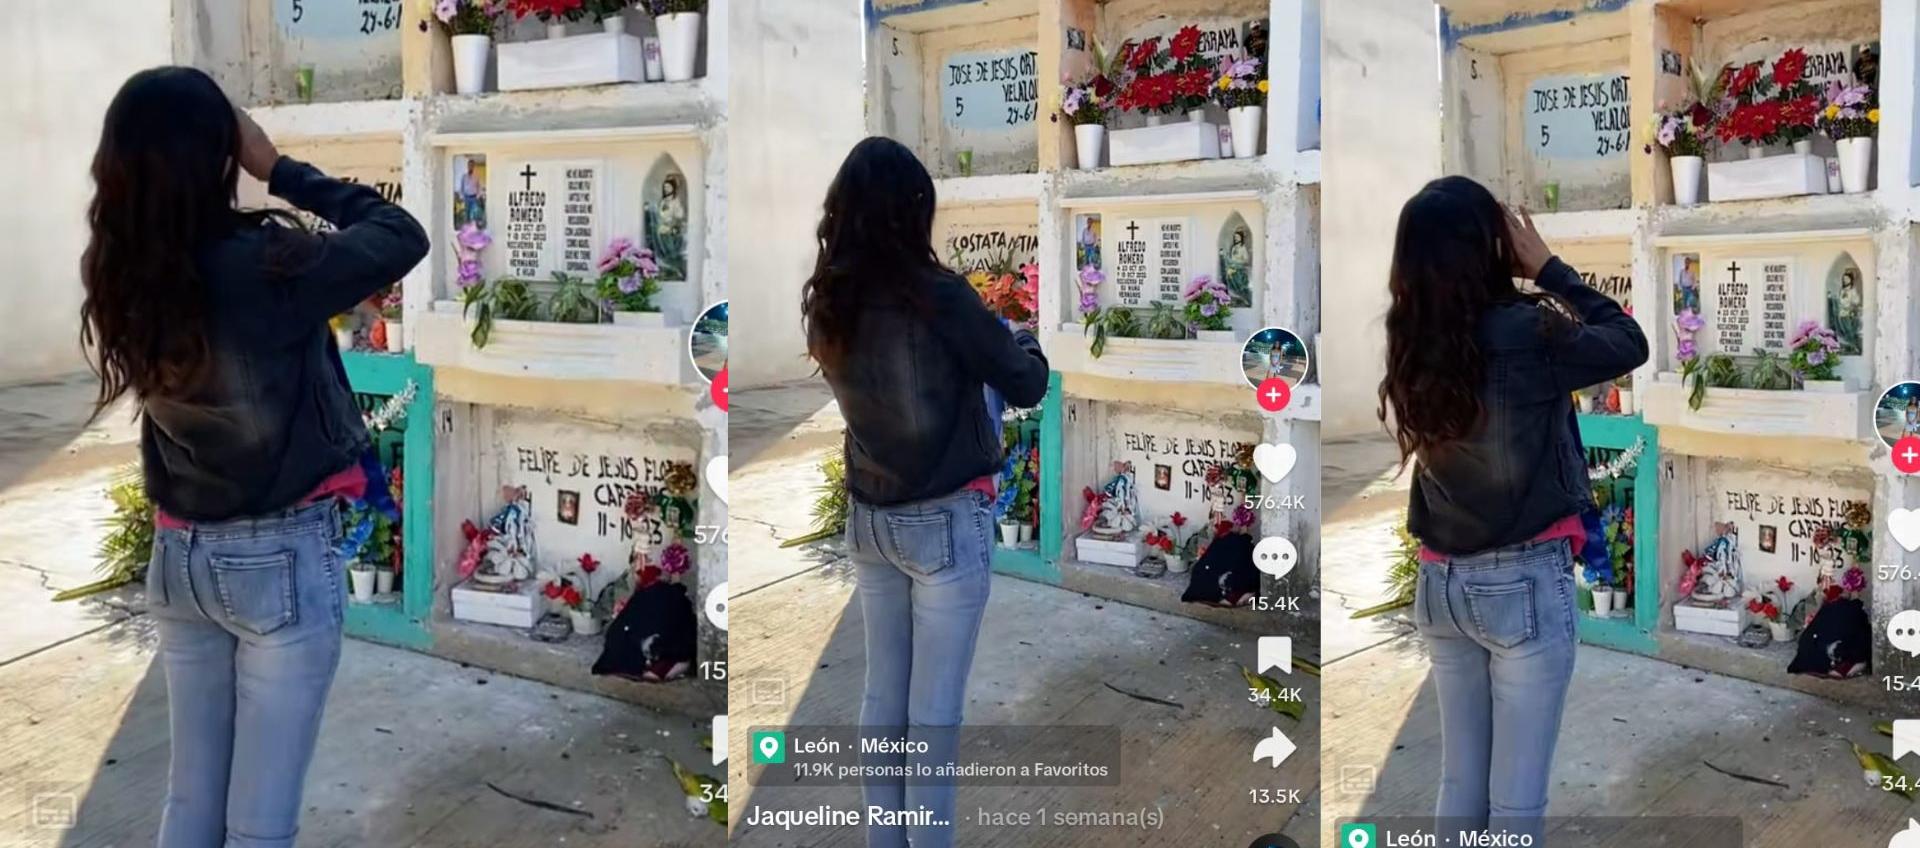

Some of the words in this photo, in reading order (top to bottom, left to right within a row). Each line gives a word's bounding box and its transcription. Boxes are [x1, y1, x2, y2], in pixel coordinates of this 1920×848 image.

[292, 0, 303, 23] 5
[948, 64, 972, 86] JOSE
[976, 61, 988, 82] DE
[990, 57, 1018, 82] JESUS
[1019, 51, 1038, 76] ORT
[1533, 88, 1559, 114] JOSE
[1563, 86, 1576, 109] DE
[1578, 81, 1608, 109] JESUS
[1610, 75, 1630, 103] ORT
[955, 96, 964, 117] 5
[1541, 124, 1550, 147] 5
[508, 191, 546, 207] ALFREDO
[510, 207, 543, 223] ROMERO
[1118, 241, 1146, 252] ALFREDO
[1119, 253, 1144, 264] ROMERO
[1718, 283, 1748, 296] ALFREDO
[1719, 296, 1746, 308] ROMERO
[1162, 439, 1179, 456] DE
[1184, 437, 1216, 458] JESUS
[568, 455, 590, 477] DE
[598, 455, 638, 481] JESUS
[1767, 496, 1785, 515] DE
[1791, 496, 1825, 518] JESUS
